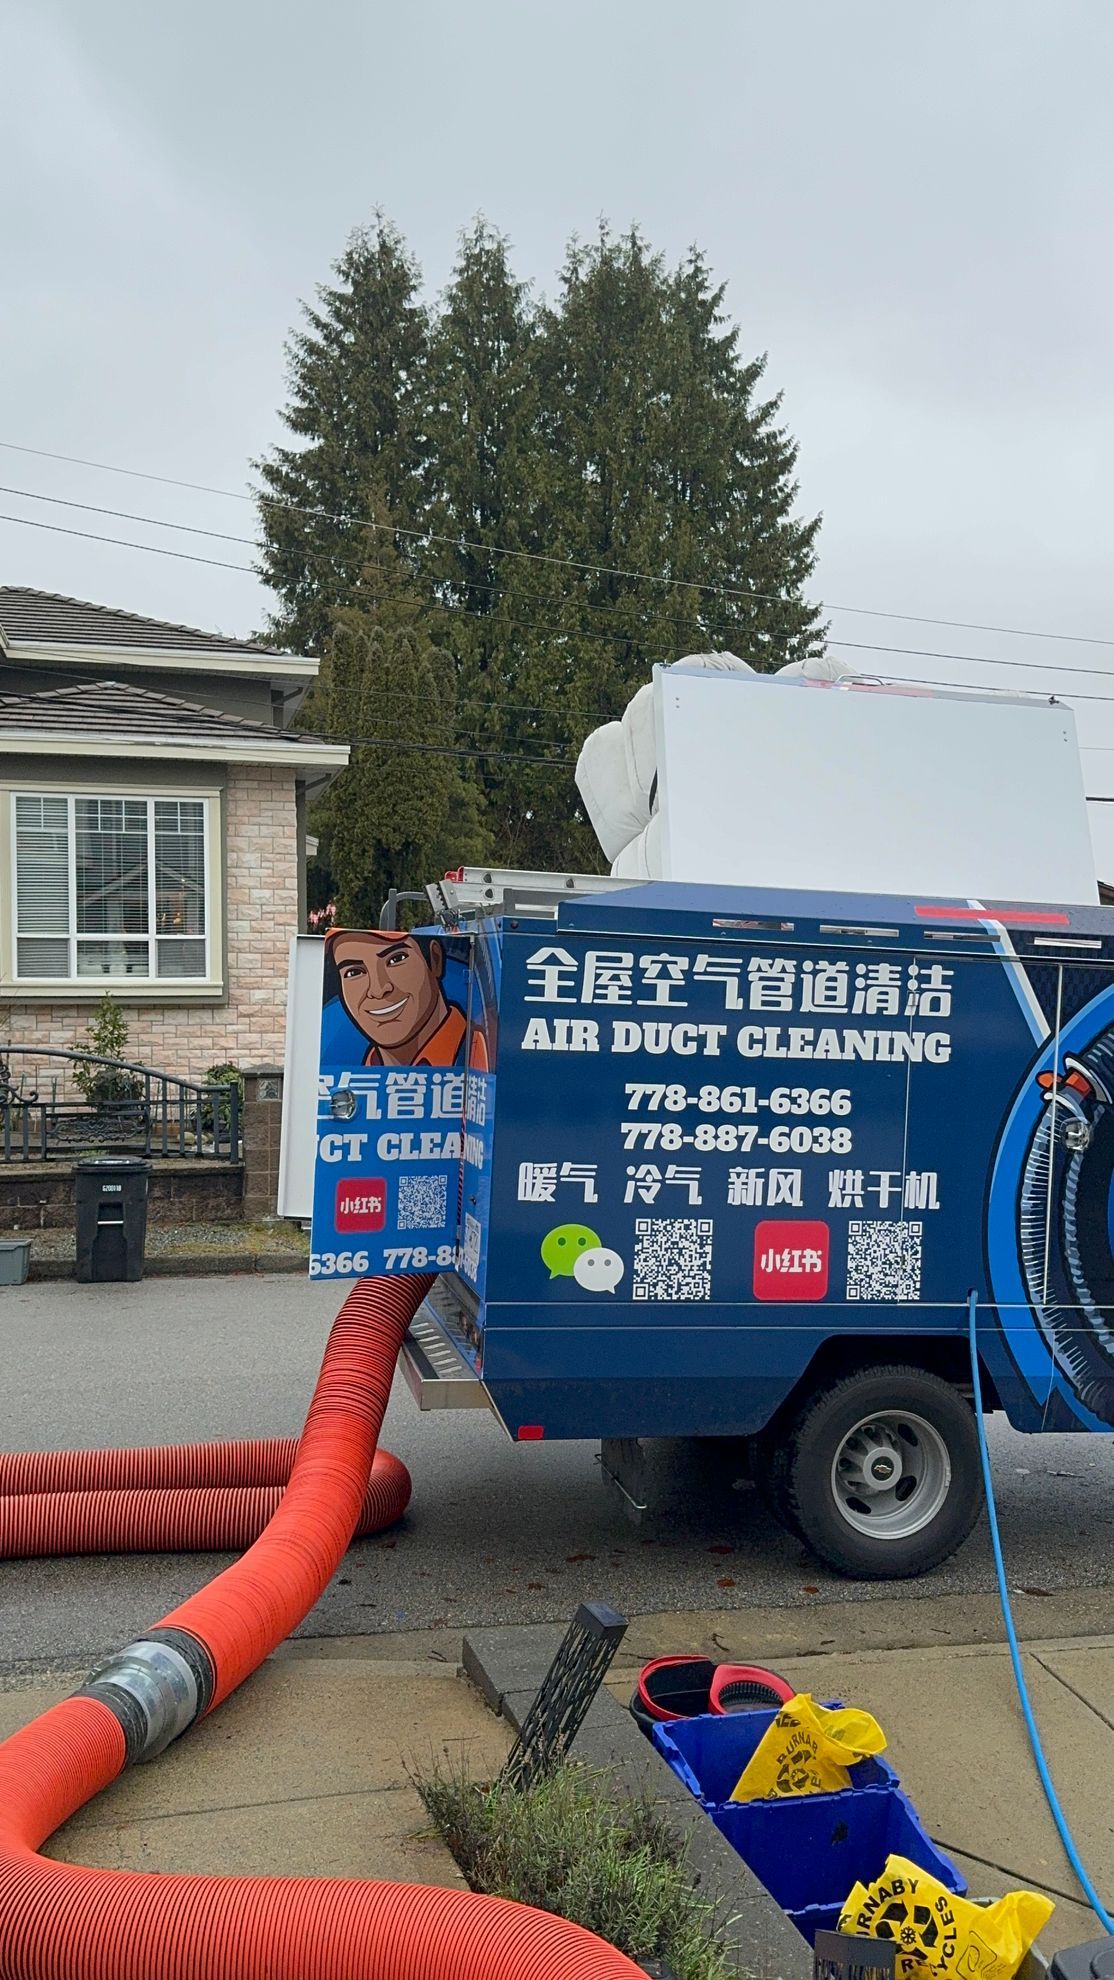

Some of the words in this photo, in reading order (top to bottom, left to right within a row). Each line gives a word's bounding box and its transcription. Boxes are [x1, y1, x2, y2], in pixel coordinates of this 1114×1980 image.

[524, 947, 954, 1017] 全屋空气管道清洁
[521, 1018, 600, 1052] AIR
[611, 1021, 727, 1055] DUCT
[736, 1025, 952, 1064] CLEANING
[625, 1083, 852, 1116] 778-861-6366
[316, 1133, 368, 1163] CT
[621, 1122, 852, 1153] 778-887-6038
[517, 1162, 598, 1203] 暖气
[624, 1164, 702, 1205] 冷气
[727, 1166, 803, 1206] 新风
[828, 1169, 940, 1209] 烘干机
[340, 1196, 382, 1214] 小红书
[760, 1248, 822, 1273] 小红书
[776, 1731, 818, 1761] BURNAB
